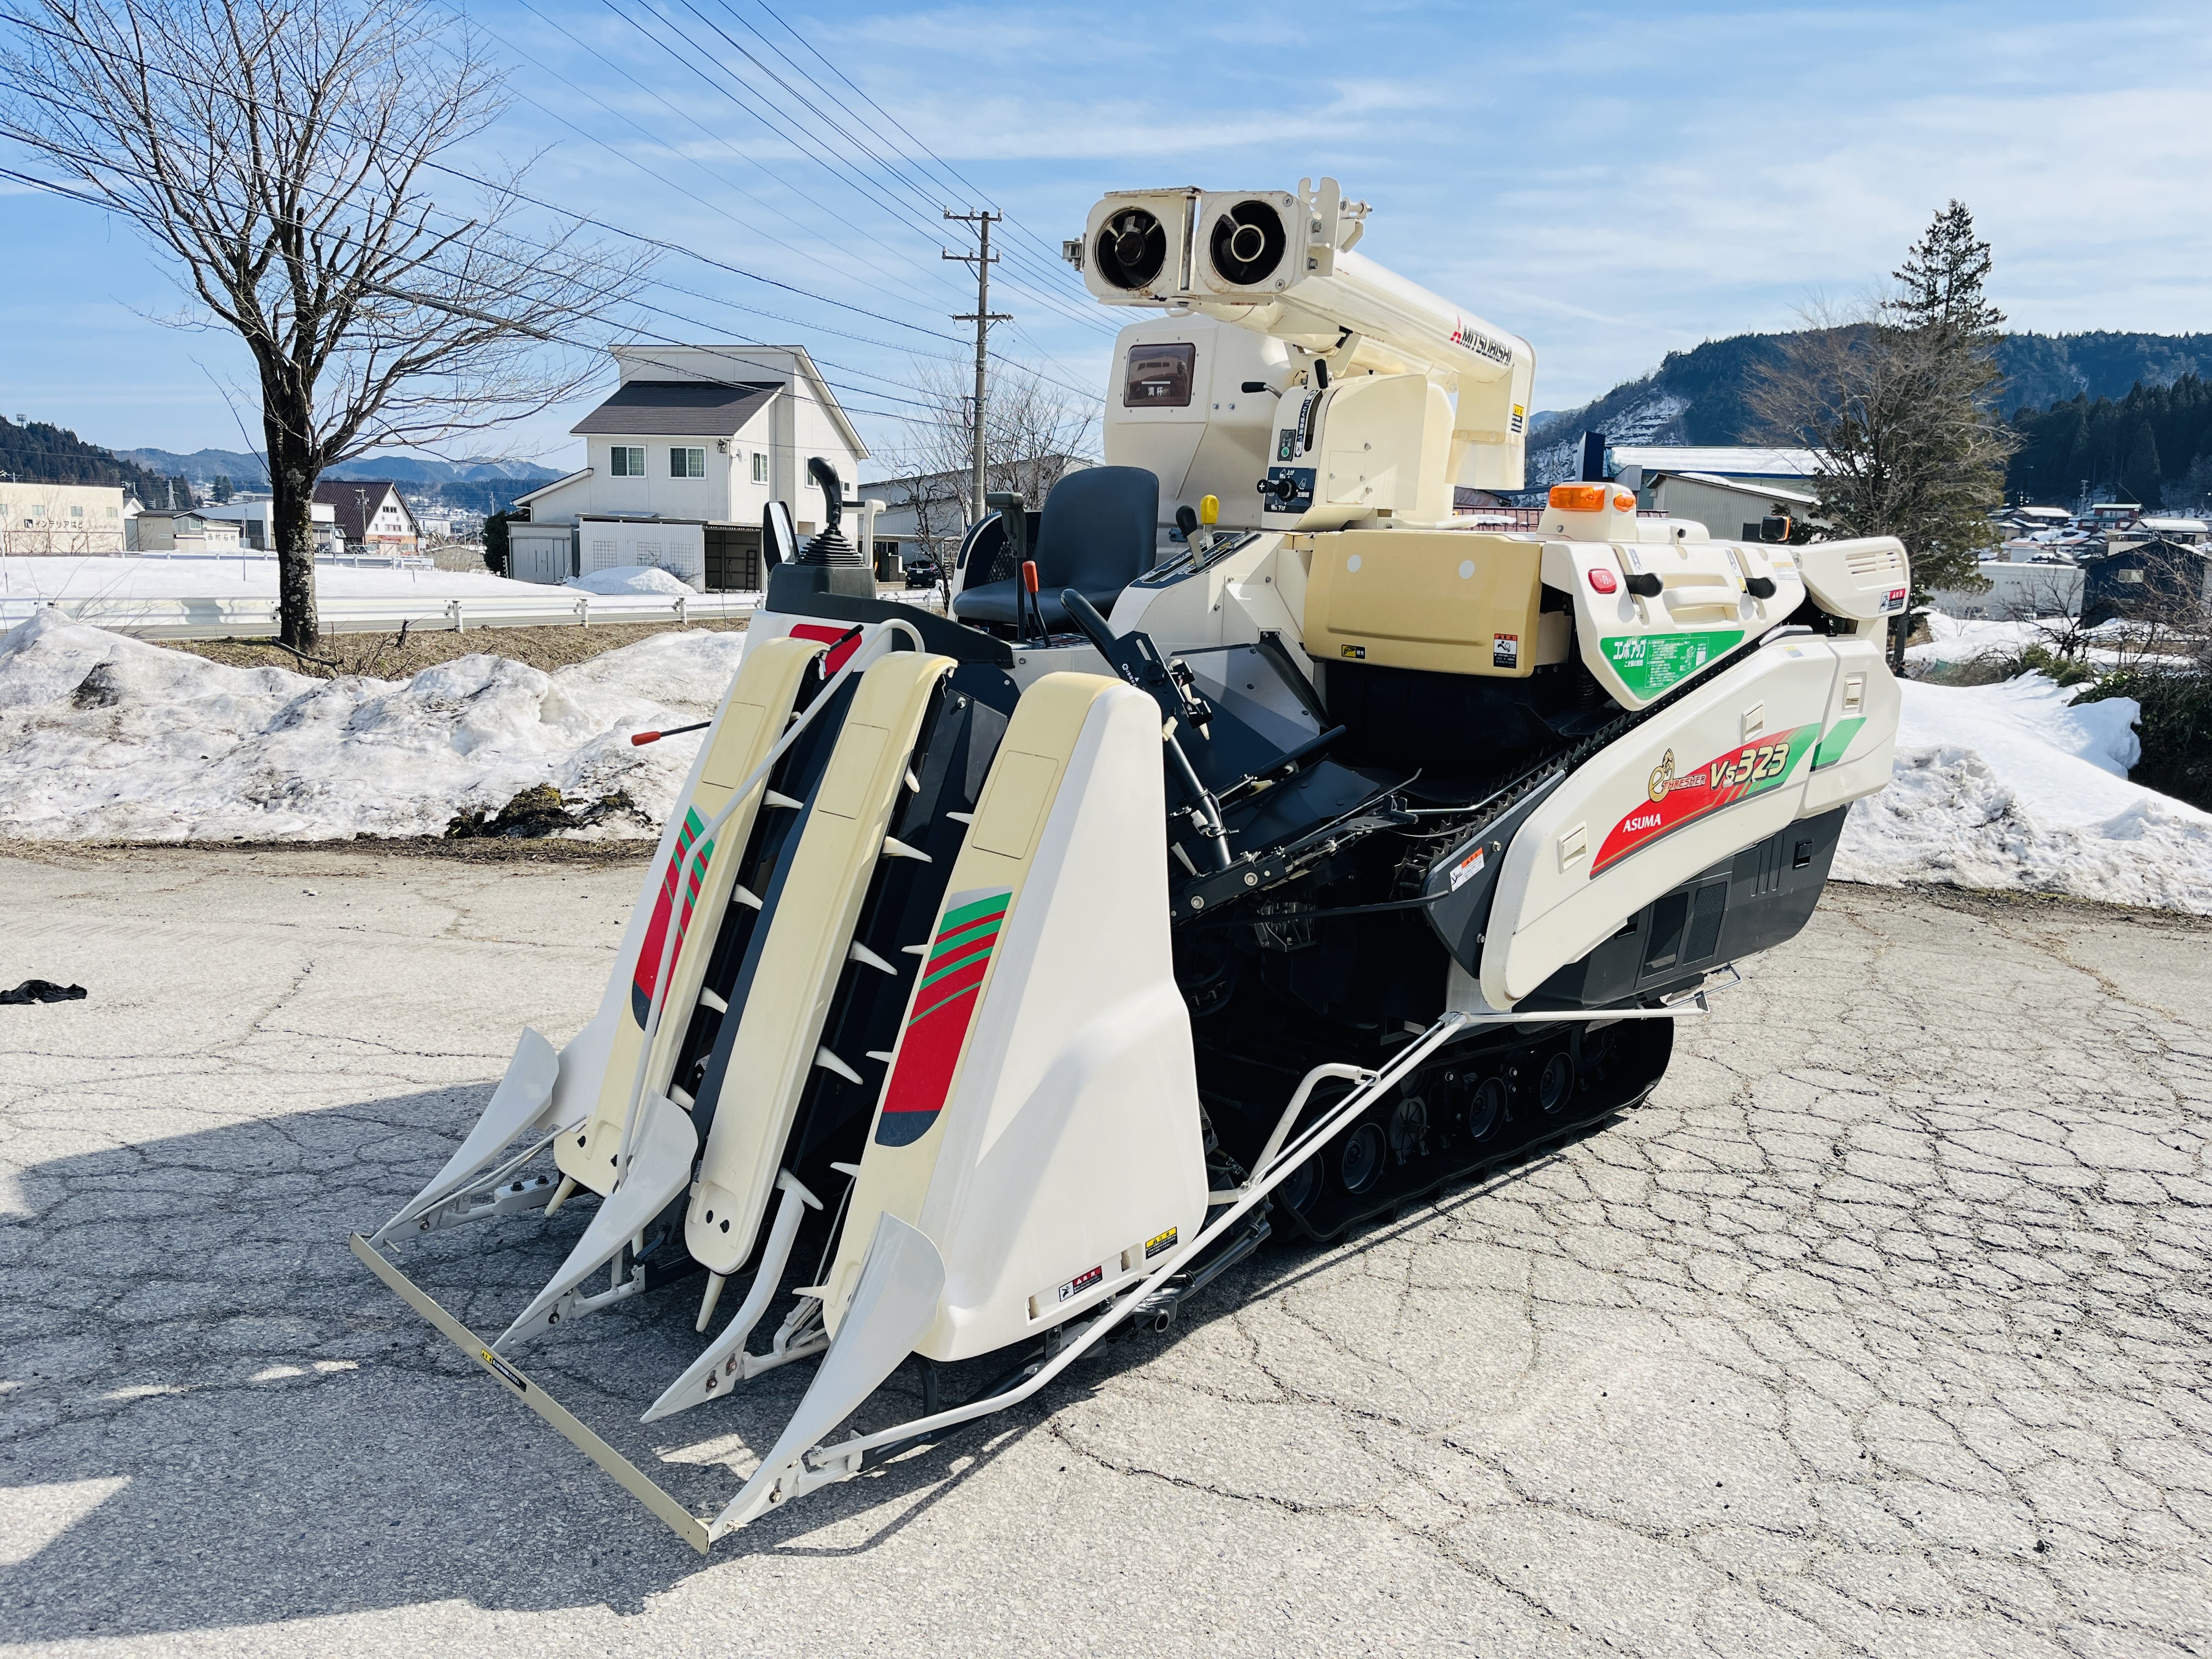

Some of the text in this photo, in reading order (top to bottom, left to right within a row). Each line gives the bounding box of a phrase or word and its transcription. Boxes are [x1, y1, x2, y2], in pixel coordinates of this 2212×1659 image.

[1460, 325, 1513, 365] MITSUBISHI
[1662, 774, 1706, 791] THRESHER
[1622, 814, 1661, 833] ASUMA
